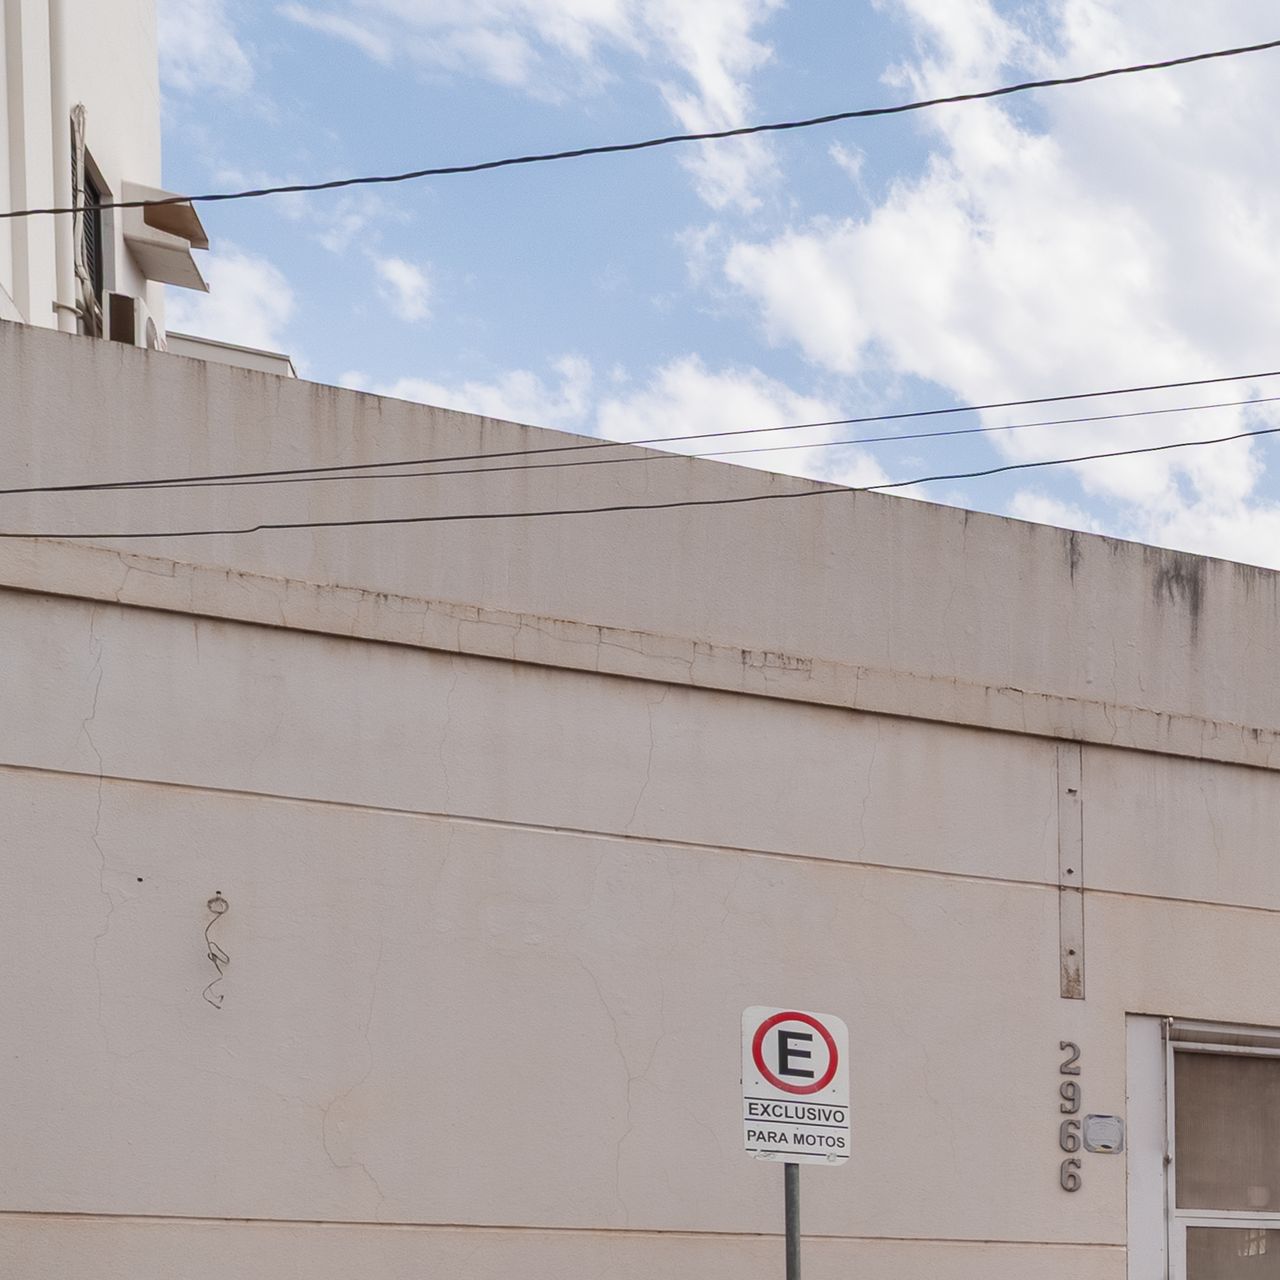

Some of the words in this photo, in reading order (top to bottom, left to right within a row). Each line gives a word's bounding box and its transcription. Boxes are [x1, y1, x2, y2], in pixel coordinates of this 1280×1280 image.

[778, 1029, 815, 1079] E
[747, 1102, 846, 1124] EXCLUSIVO
[1059, 1040, 1082, 1193] 2966
[746, 1129, 789, 1145] PARA
[792, 1132, 846, 1149] MOTOS
